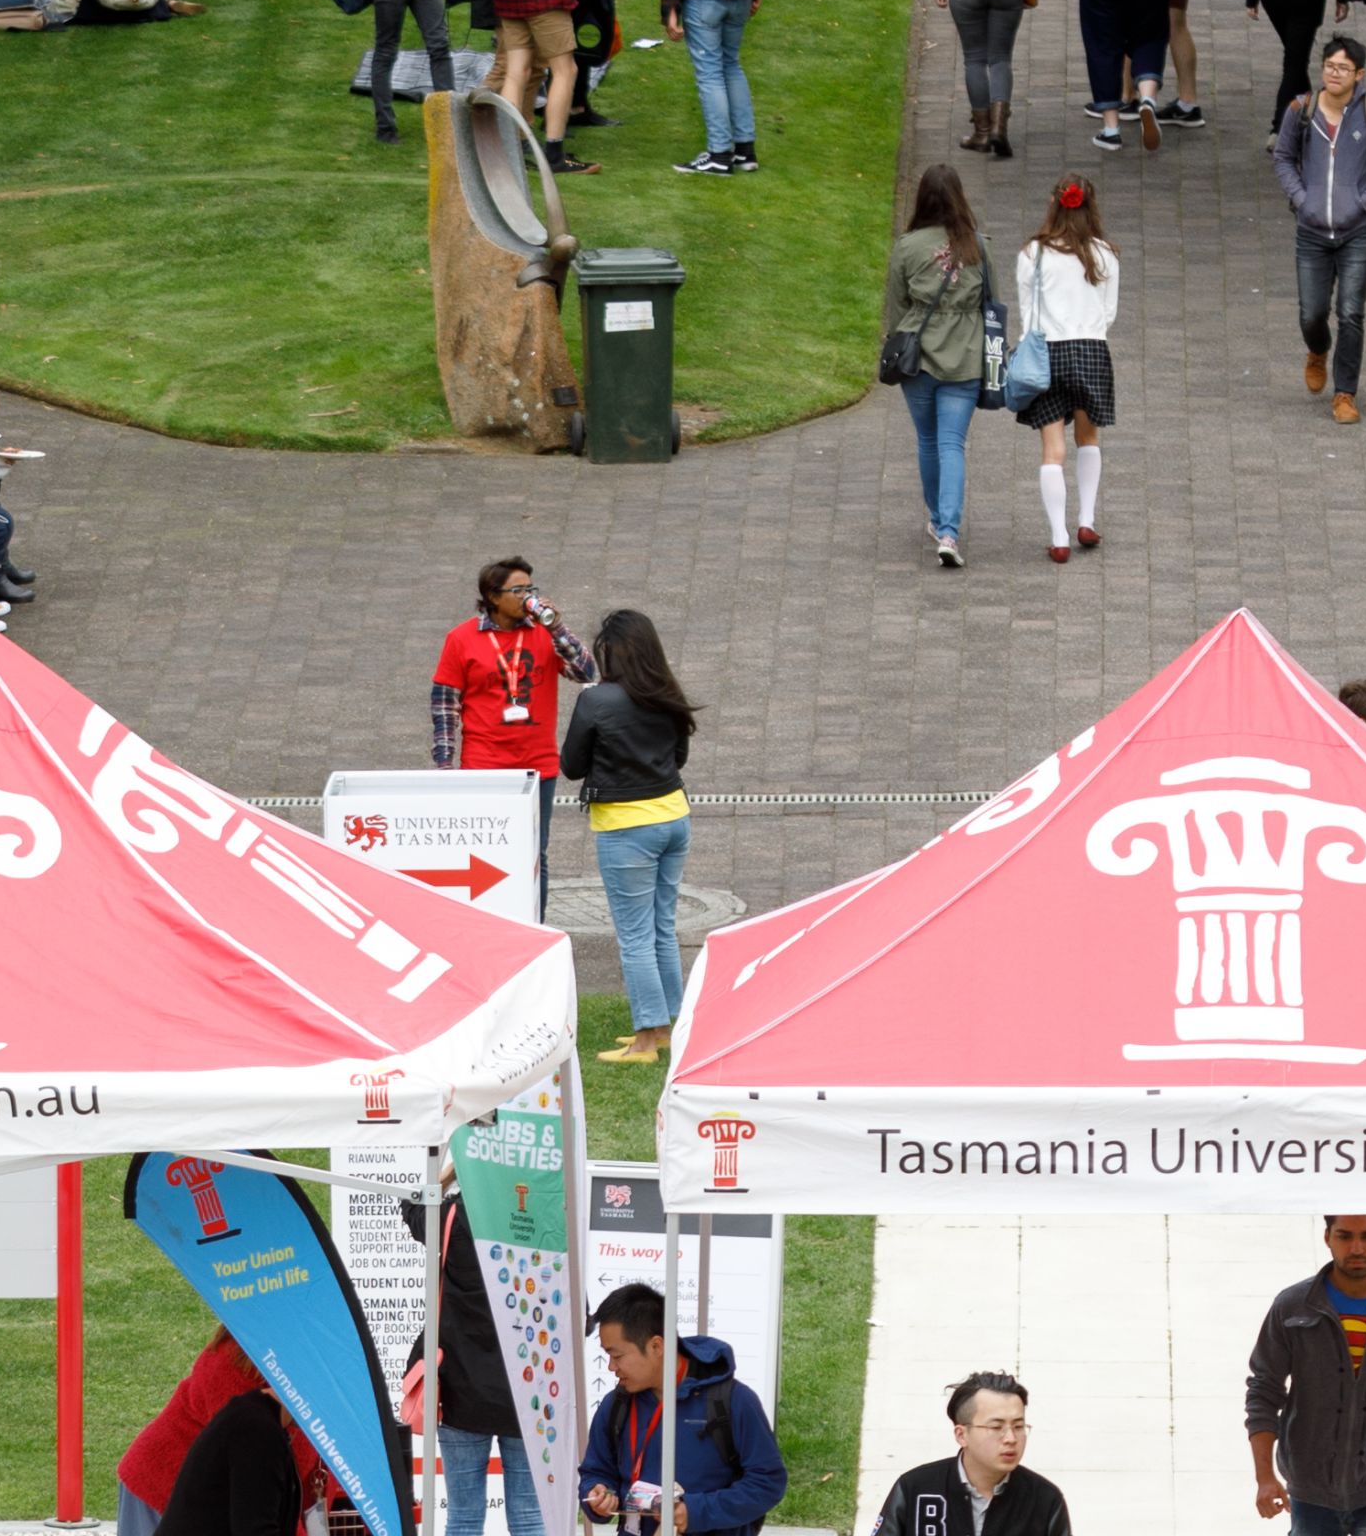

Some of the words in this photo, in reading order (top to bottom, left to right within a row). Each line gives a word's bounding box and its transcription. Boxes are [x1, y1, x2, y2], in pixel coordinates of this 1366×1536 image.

[395, 817, 497, 830] UNIVERSITY
[497, 816, 511, 827] of
[395, 833, 510, 845] TASMANIA
[541, 1124, 555, 1148] &
[466, 1135, 563, 1172] SOCIETIES
[868, 1128, 1128, 1175] Tasmania
[348, 1154, 396, 1163] RIAWUNA
[349, 1194, 393, 1204] MORRIS
[349, 1205, 401, 1216] BREEZEW
[350, 1220, 398, 1230] WELCOME
[350, 1232, 393, 1242] STUDENT
[396, 1232, 413, 1242] EXP
[350, 1244, 392, 1254] SUPPORT
[394, 1244, 418, 1254] HUB
[598, 1243, 626, 1257] This
[631, 1248, 663, 1262] way
[212, 1258, 248, 1278] Your
[250, 1245, 294, 1271] Union
[349, 1258, 369, 1269] JOB
[372, 1258, 387, 1268] ON
[390, 1258, 425, 1268] CAMPU
[220, 1282, 255, 1303] Your
[258, 1274, 283, 1293] Uni
[285, 1266, 310, 1287] life
[402, 1278, 426, 1288] LOU
[364, 1298, 408, 1309] SMANIA
[384, 1323, 425, 1333] BOOKSH
[382, 1335, 415, 1344] LOUNG
[262, 1348, 313, 1419] Tasmania
[309, 1416, 366, 1501] University
